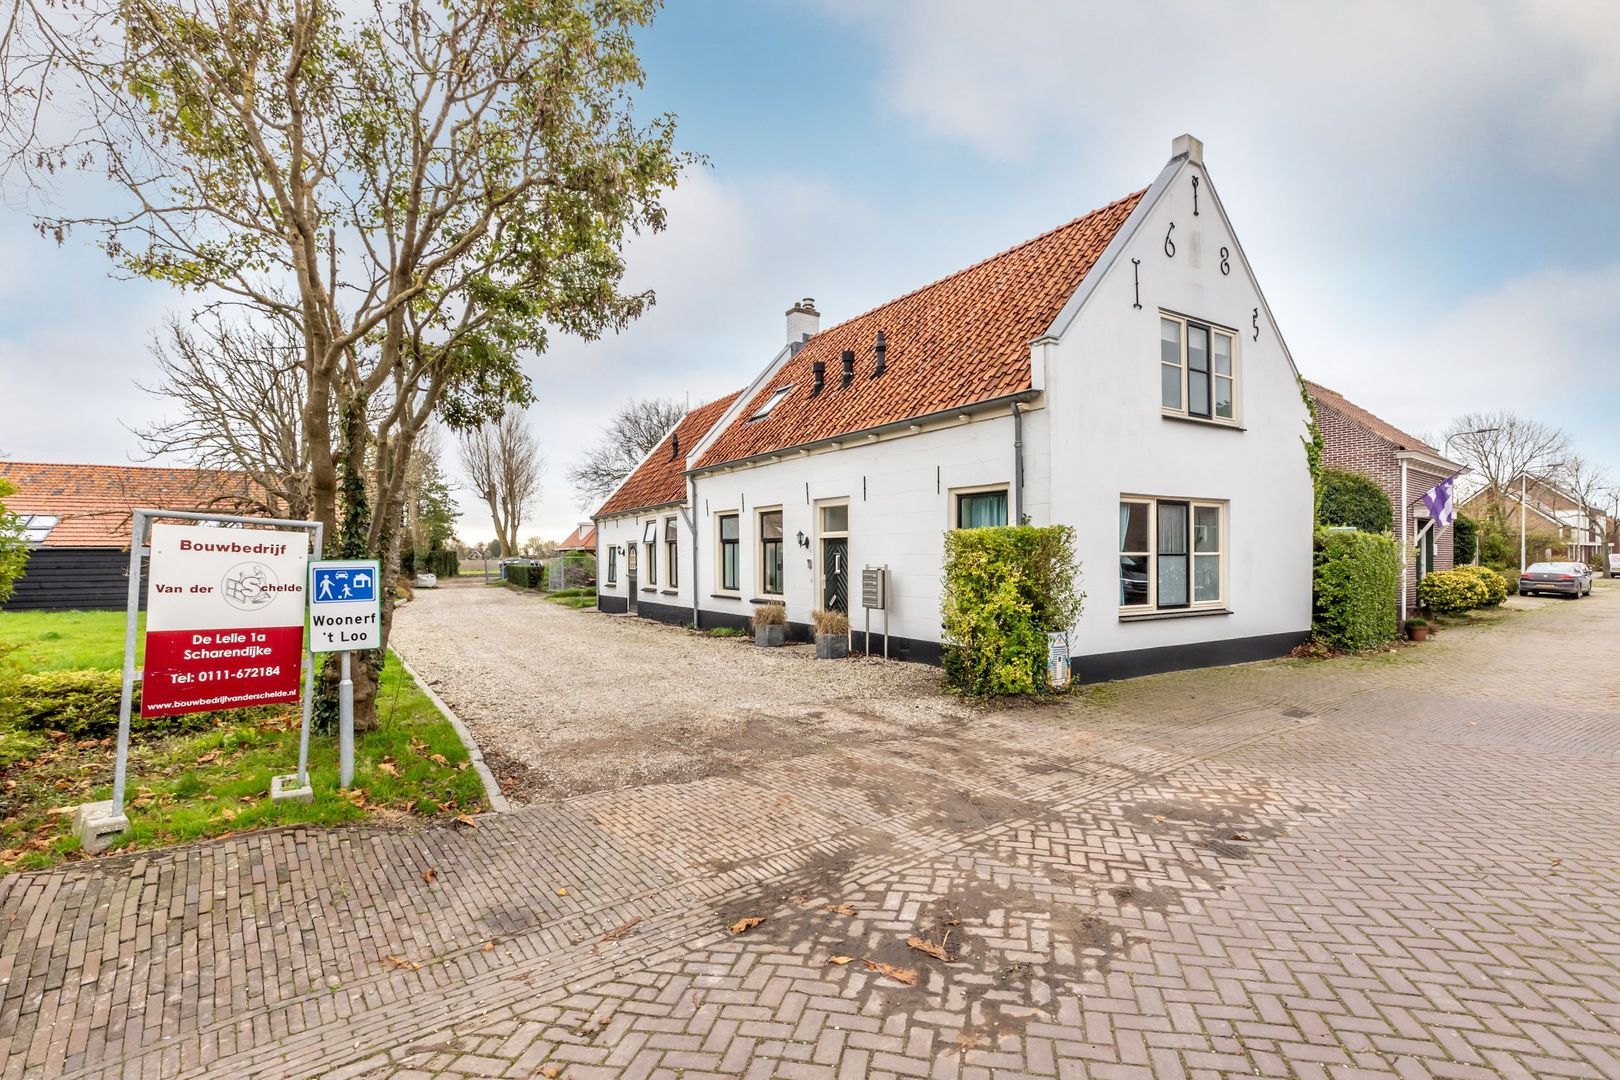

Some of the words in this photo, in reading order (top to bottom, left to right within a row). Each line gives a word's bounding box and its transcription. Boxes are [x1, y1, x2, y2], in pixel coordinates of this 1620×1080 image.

[180, 540, 287, 556] Bouwbedrijf
[156, 584, 183, 593] Van
[190, 584, 213, 593] der
[313, 612, 376, 627] Woonerf
[192, 634, 212, 645] De
[216, 633, 246, 643] Lelie
[250, 633, 266, 643] 1a
[341, 632, 367, 642] Loo
[184, 646, 272, 661] Scharendijke
[171, 672, 195, 684] Tel:
[198, 666, 280, 682] 0111-672184
[147, 689, 296, 710] www.bouwbedrijfvanderschelde.nl
